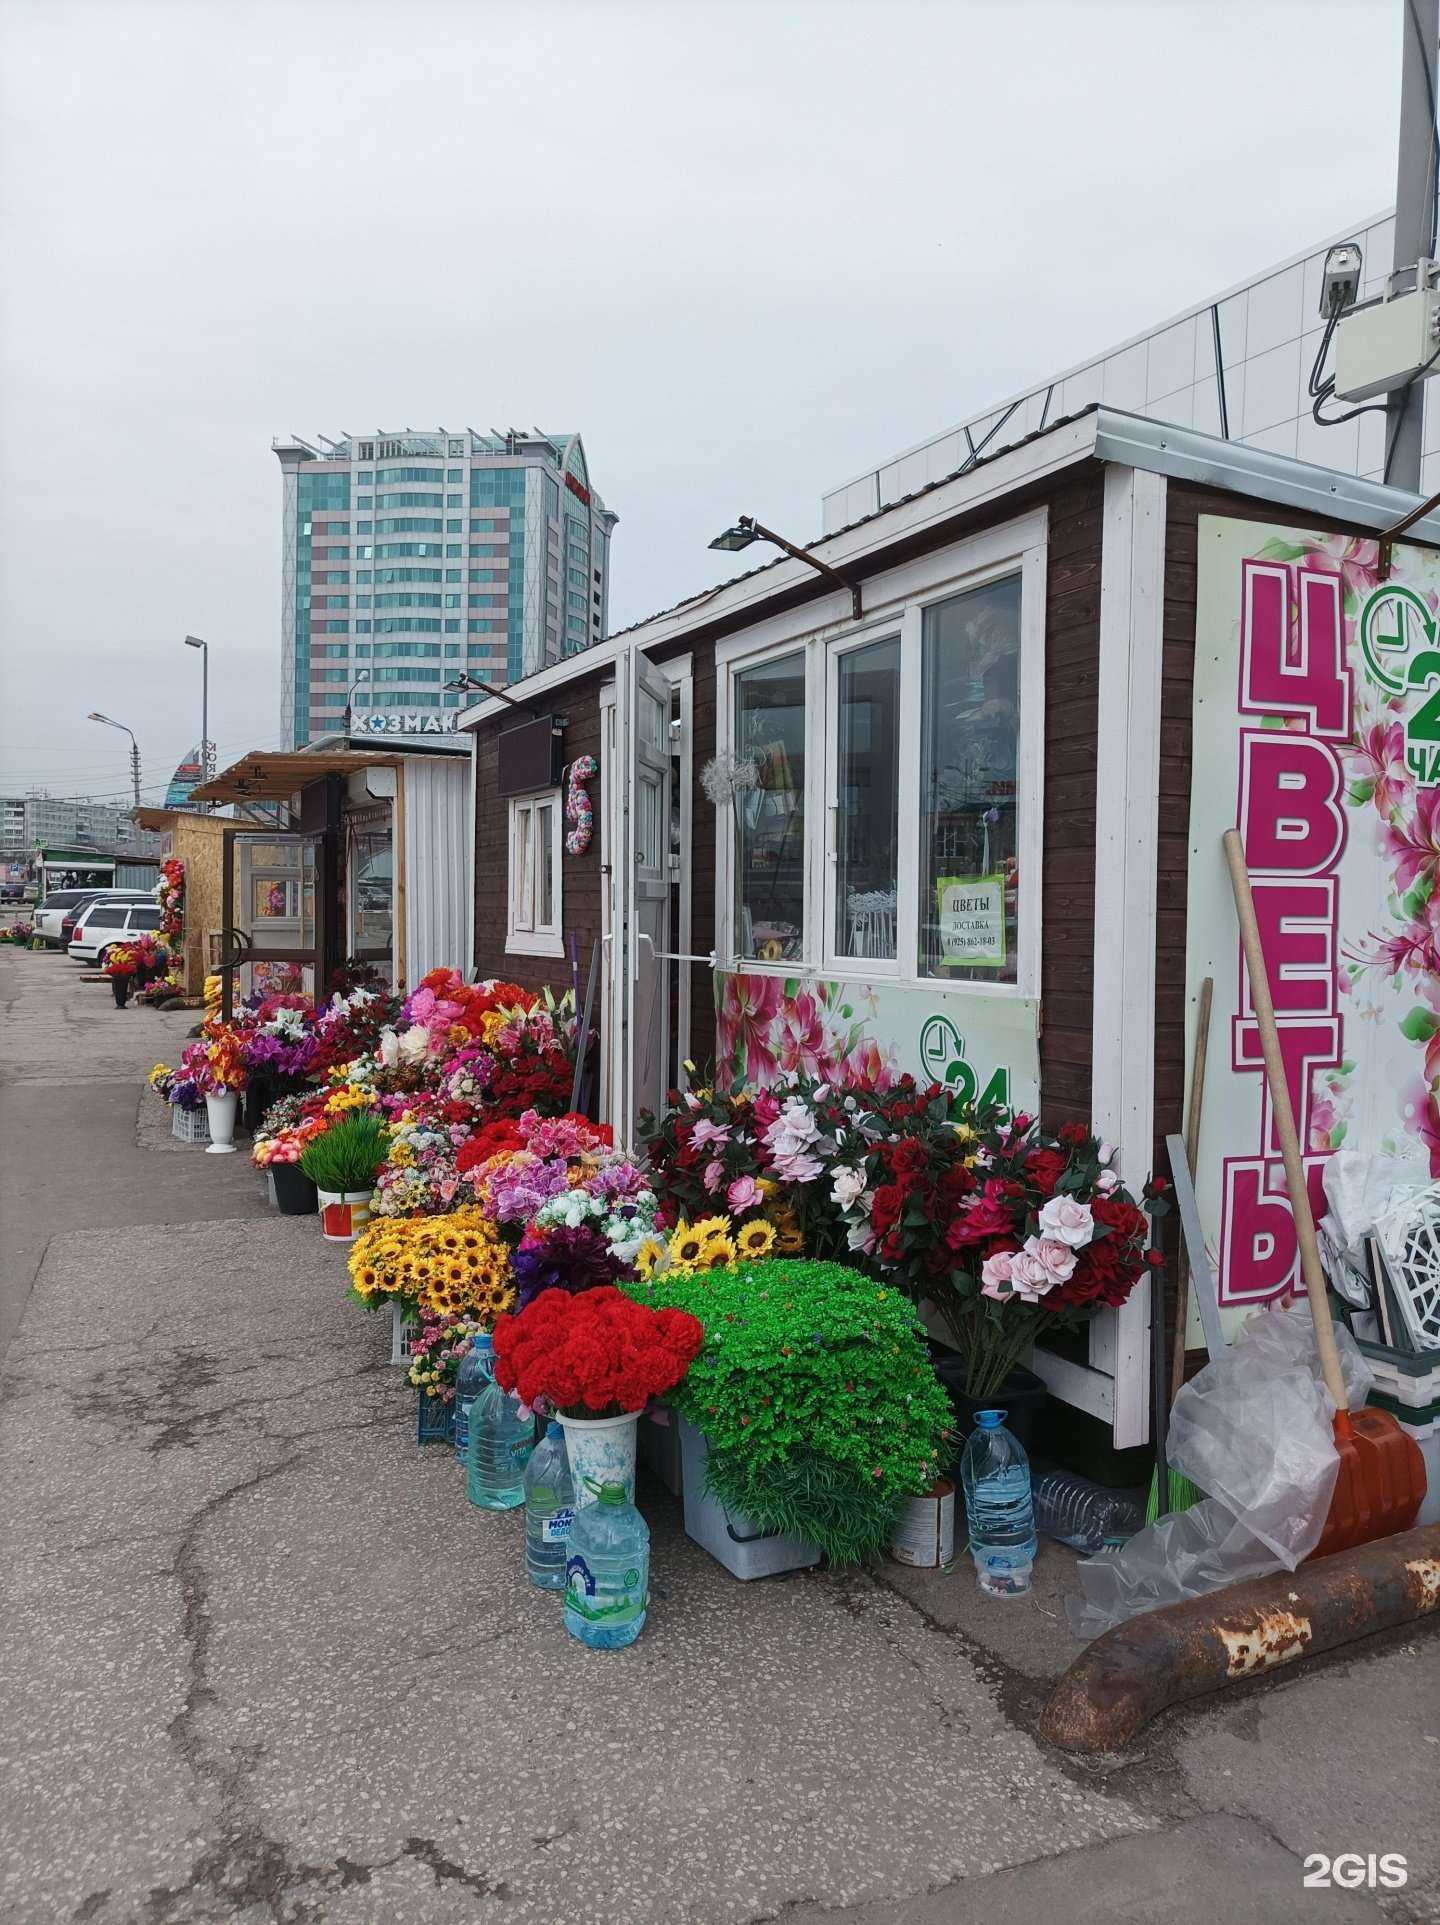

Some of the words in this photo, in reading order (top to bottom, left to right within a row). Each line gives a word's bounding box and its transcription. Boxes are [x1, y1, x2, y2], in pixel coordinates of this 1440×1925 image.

[952, 897, 990, 912] ЦВЕТЫ
[952, 921, 989, 931] ДОСТАВКА
[1218, 558, 1354, 1307] ЦВЕТЫ
[945, 1060, 1011, 1126] 24
